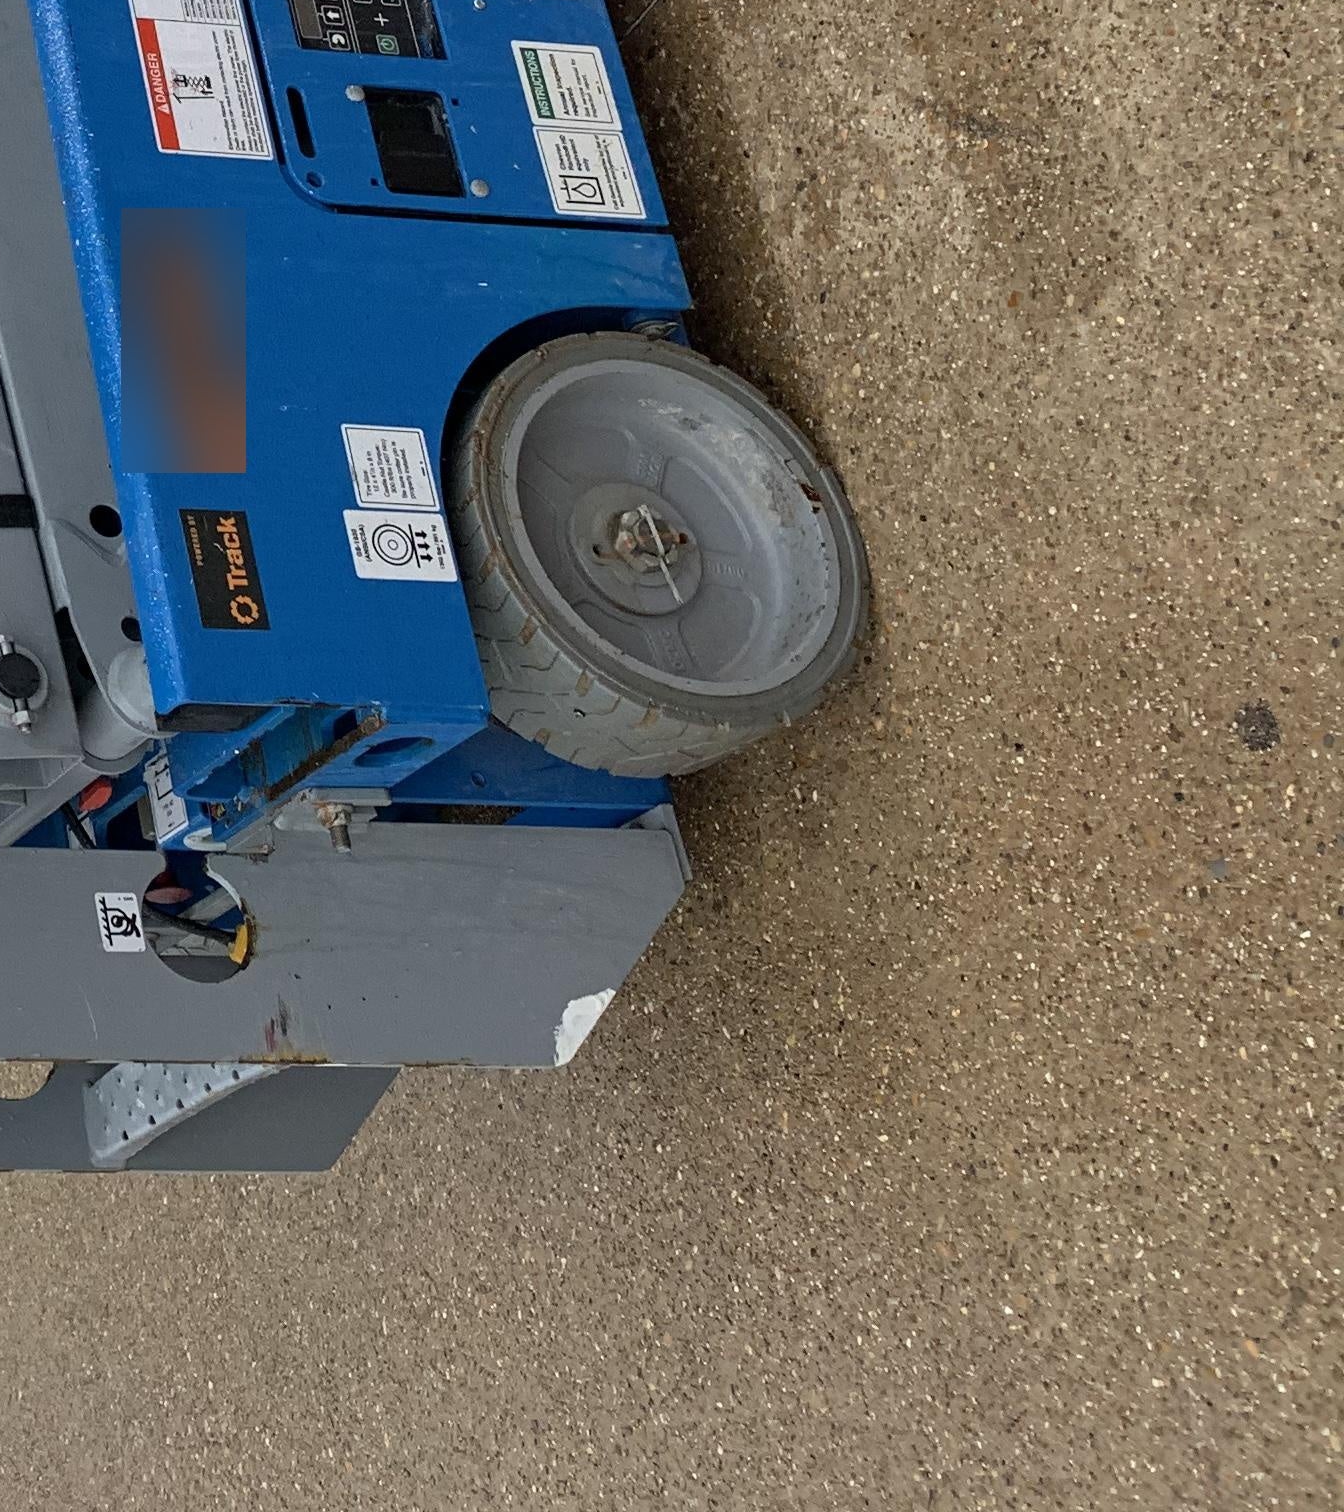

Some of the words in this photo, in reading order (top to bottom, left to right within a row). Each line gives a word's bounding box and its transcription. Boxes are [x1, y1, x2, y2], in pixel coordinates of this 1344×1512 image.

[146, 53, 166, 103] DANGER
[524, 50, 551, 117] INSTRUCTIONS
[189, 528, 203, 566] POWERED
[214, 517, 249, 590] Track
